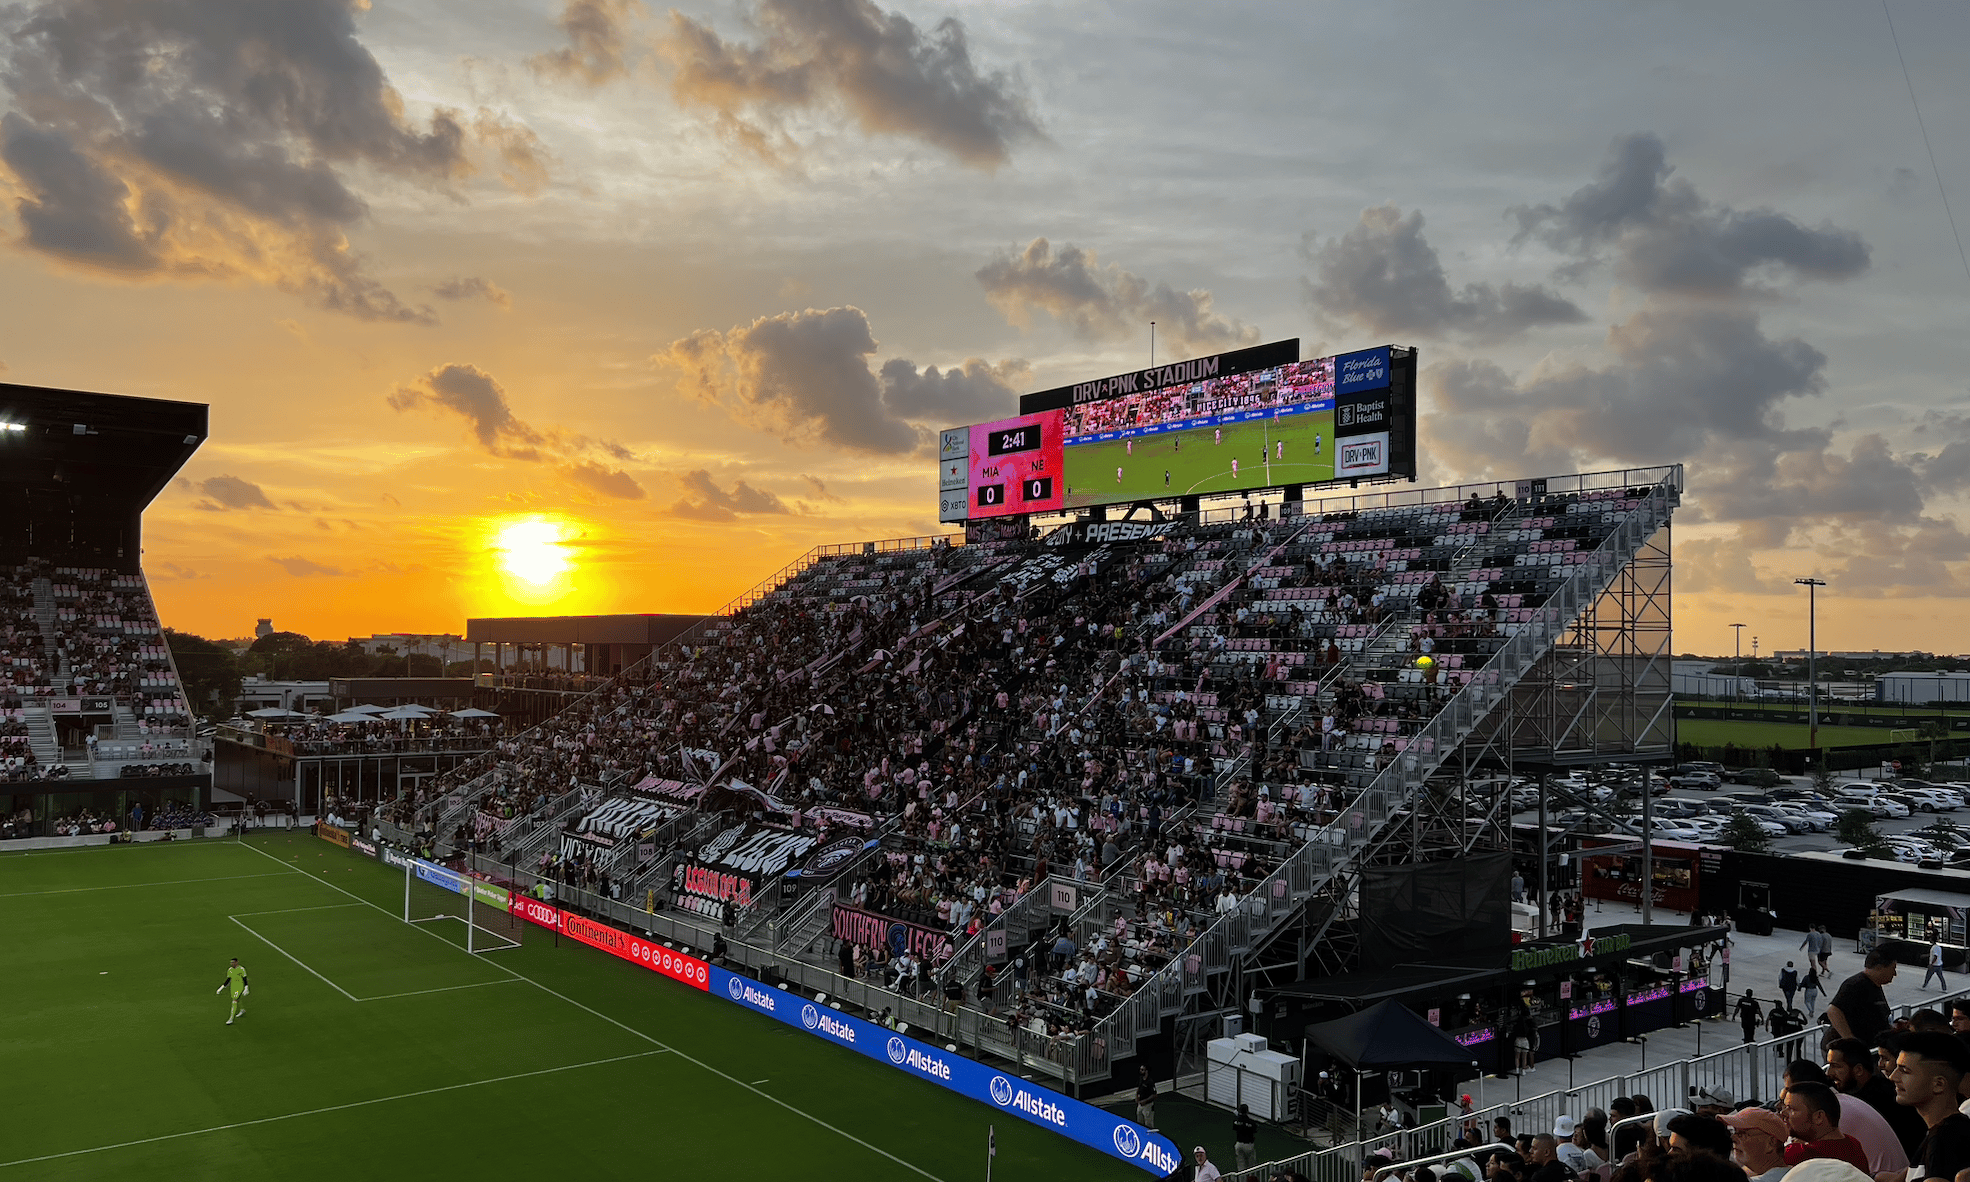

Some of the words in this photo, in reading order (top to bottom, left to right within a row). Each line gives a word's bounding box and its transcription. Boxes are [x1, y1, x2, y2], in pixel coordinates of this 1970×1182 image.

[1343, 356, 1382, 372] Florida
[1073, 381, 1101, 403] DRV
[1109, 373, 1138, 396] PNK
[1143, 356, 1219, 389] STADIUM
[1342, 372, 1364, 384] Blue
[1356, 400, 1385, 413] Baptist
[1356, 411, 1382, 424] Health
[1002, 431, 1025, 449] 2:41
[1345, 449, 1359, 463] DRV
[1362, 446, 1377, 461] PNK
[982, 466, 999, 478] MIA
[1031, 459, 1044, 472] NE
[941, 477, 966, 487] Heineken
[1518, 486, 1530, 494] 110
[1534, 484, 1545, 493] 111
[986, 486, 995, 504] 0
[1032, 480, 1042, 498] 0
[950, 501, 966, 511] XBTO
[1085, 521, 1176, 543] PRESENTE
[94, 701, 108, 709] 105
[685, 864, 720, 900] LEGION
[783, 884, 798, 894] 109
[1057, 890, 1070, 903] 110
[568, 914, 617, 948] Continental
[832, 906, 888, 951] SOUTHERN
[990, 936, 1003, 948] 110
[1511, 943, 1579, 971] Heineken
[1596, 936, 1615, 955] STAR
[1615, 932, 1631, 952] BAR
[743, 985, 775, 1012] Allstate
[818, 1014, 855, 1043] Allstate
[906, 1048, 950, 1080] Allstate
[1013, 1089, 1066, 1126] Allstate
